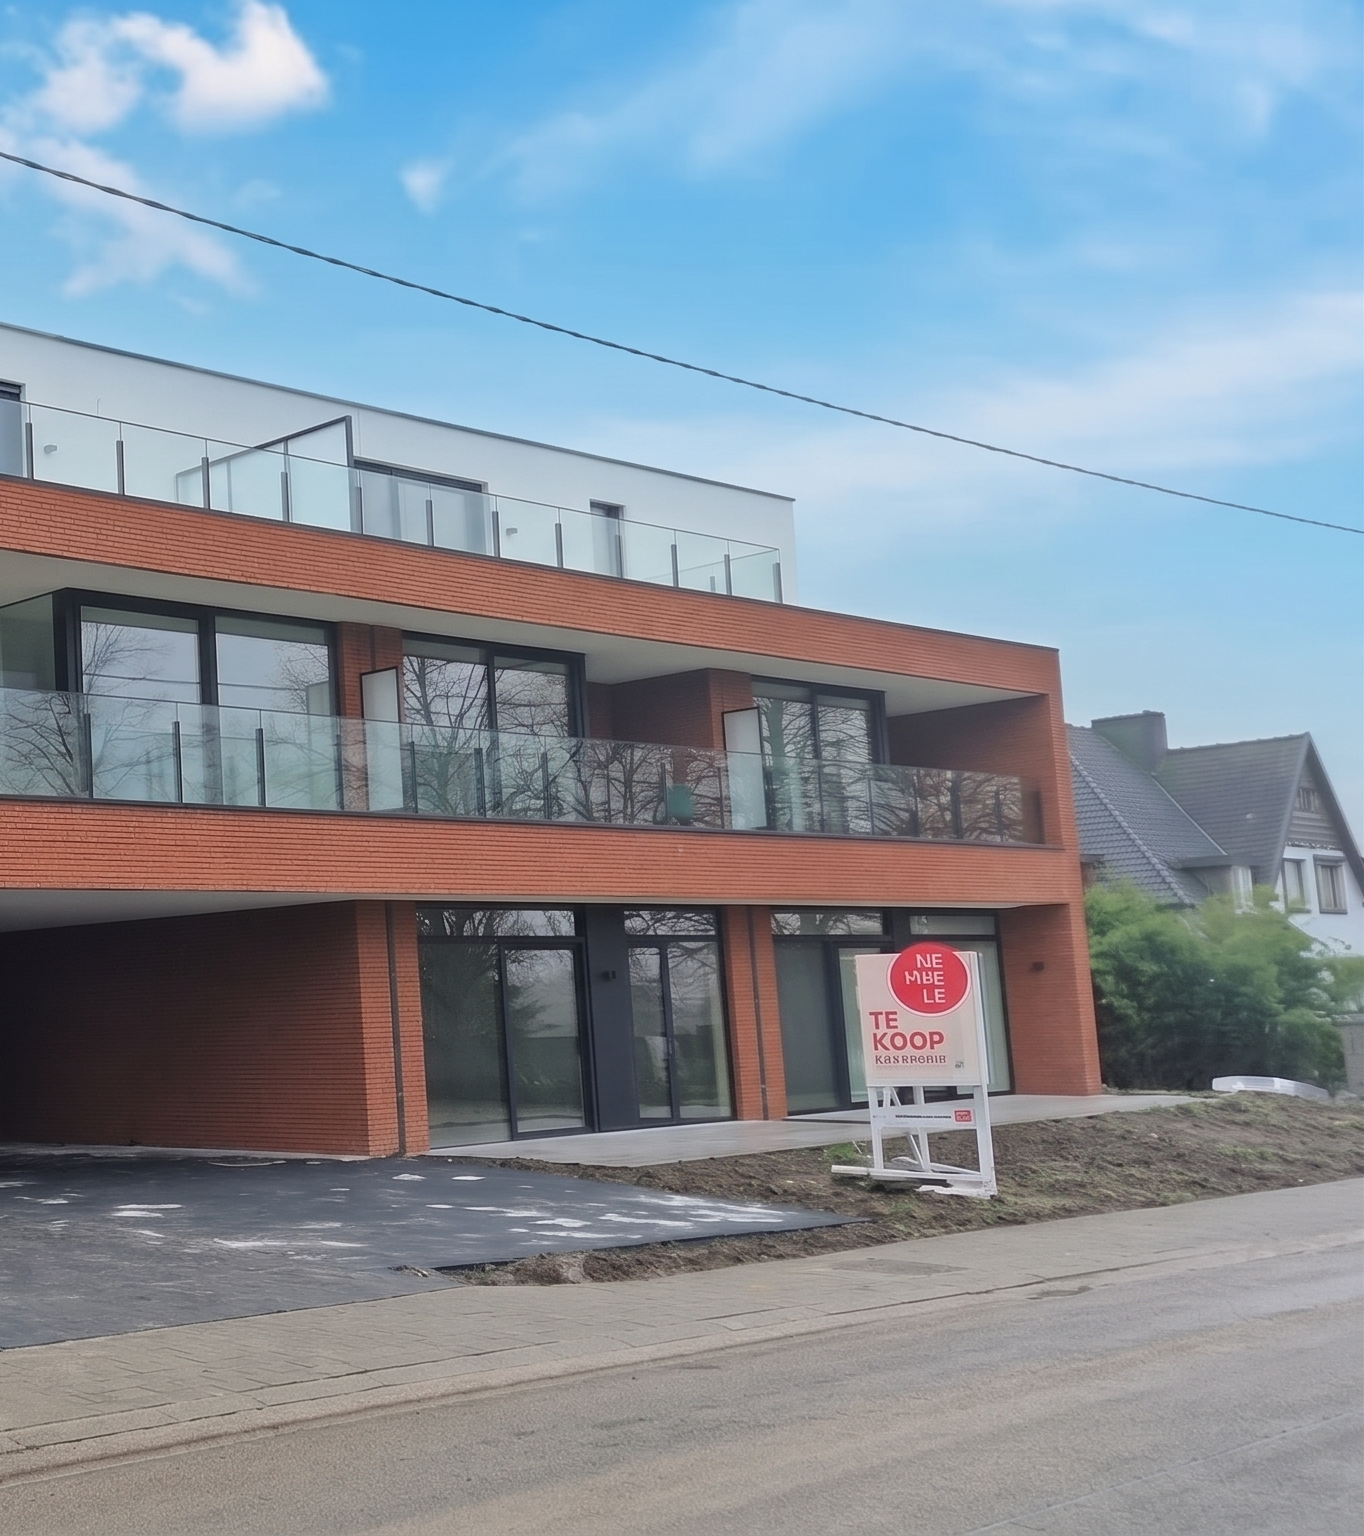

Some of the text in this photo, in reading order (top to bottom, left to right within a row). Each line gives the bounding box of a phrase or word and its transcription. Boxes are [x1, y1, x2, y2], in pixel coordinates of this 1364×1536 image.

[916, 953, 943, 968] NE
[904, 970, 945, 985] MBE
[923, 988, 946, 1004] LE
[869, 1010, 898, 1030] TE
[872, 1031, 945, 1051] KOOP
